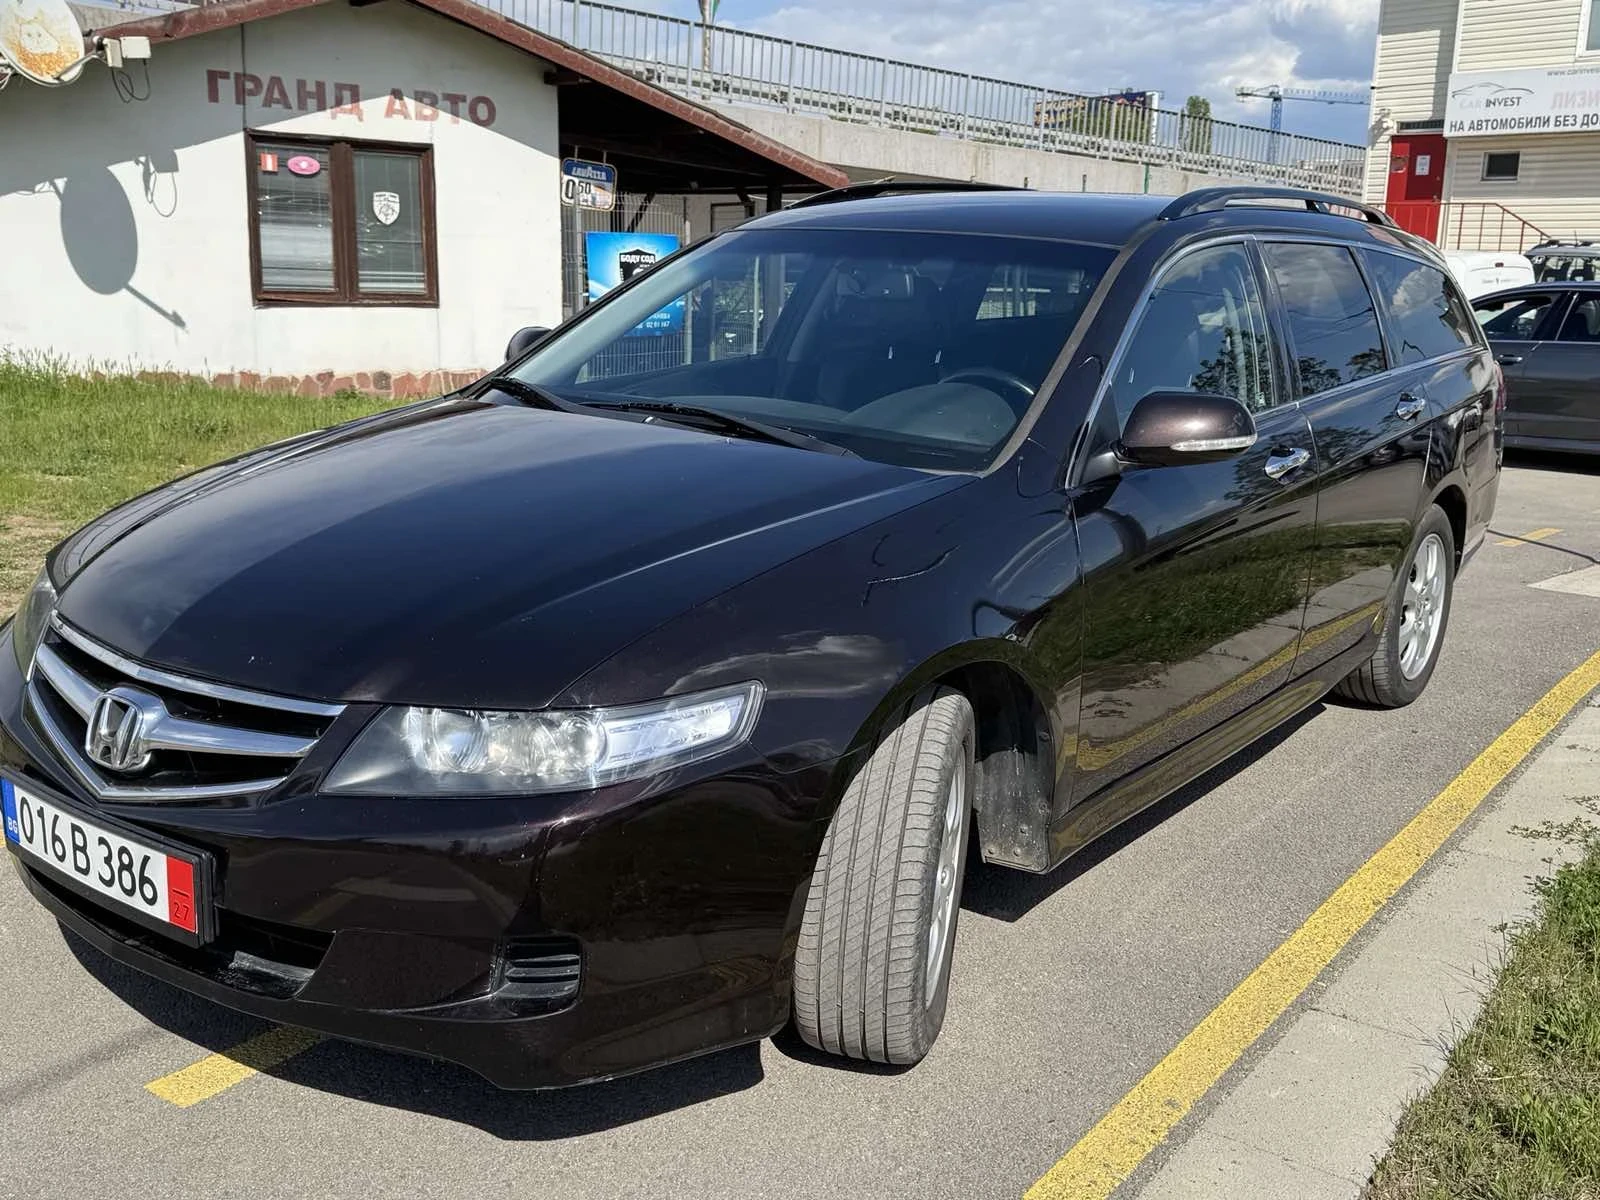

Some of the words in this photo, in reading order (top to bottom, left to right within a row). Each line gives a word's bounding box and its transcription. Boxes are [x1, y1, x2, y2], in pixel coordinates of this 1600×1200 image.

[206, 68, 364, 122] ГРАНД
[384, 87, 497, 127] АВТО
[1485, 96, 1522, 108] INVEST
[1449, 120, 1464, 133] НА
[1468, 115, 1551, 131] АВТОМОБИЛИ
[1554, 114, 1577, 127] БЕЗ
[1580, 112, 1600, 129] ДО
[7, 816, 18, 835] BG
[173, 901, 189, 921] 27
